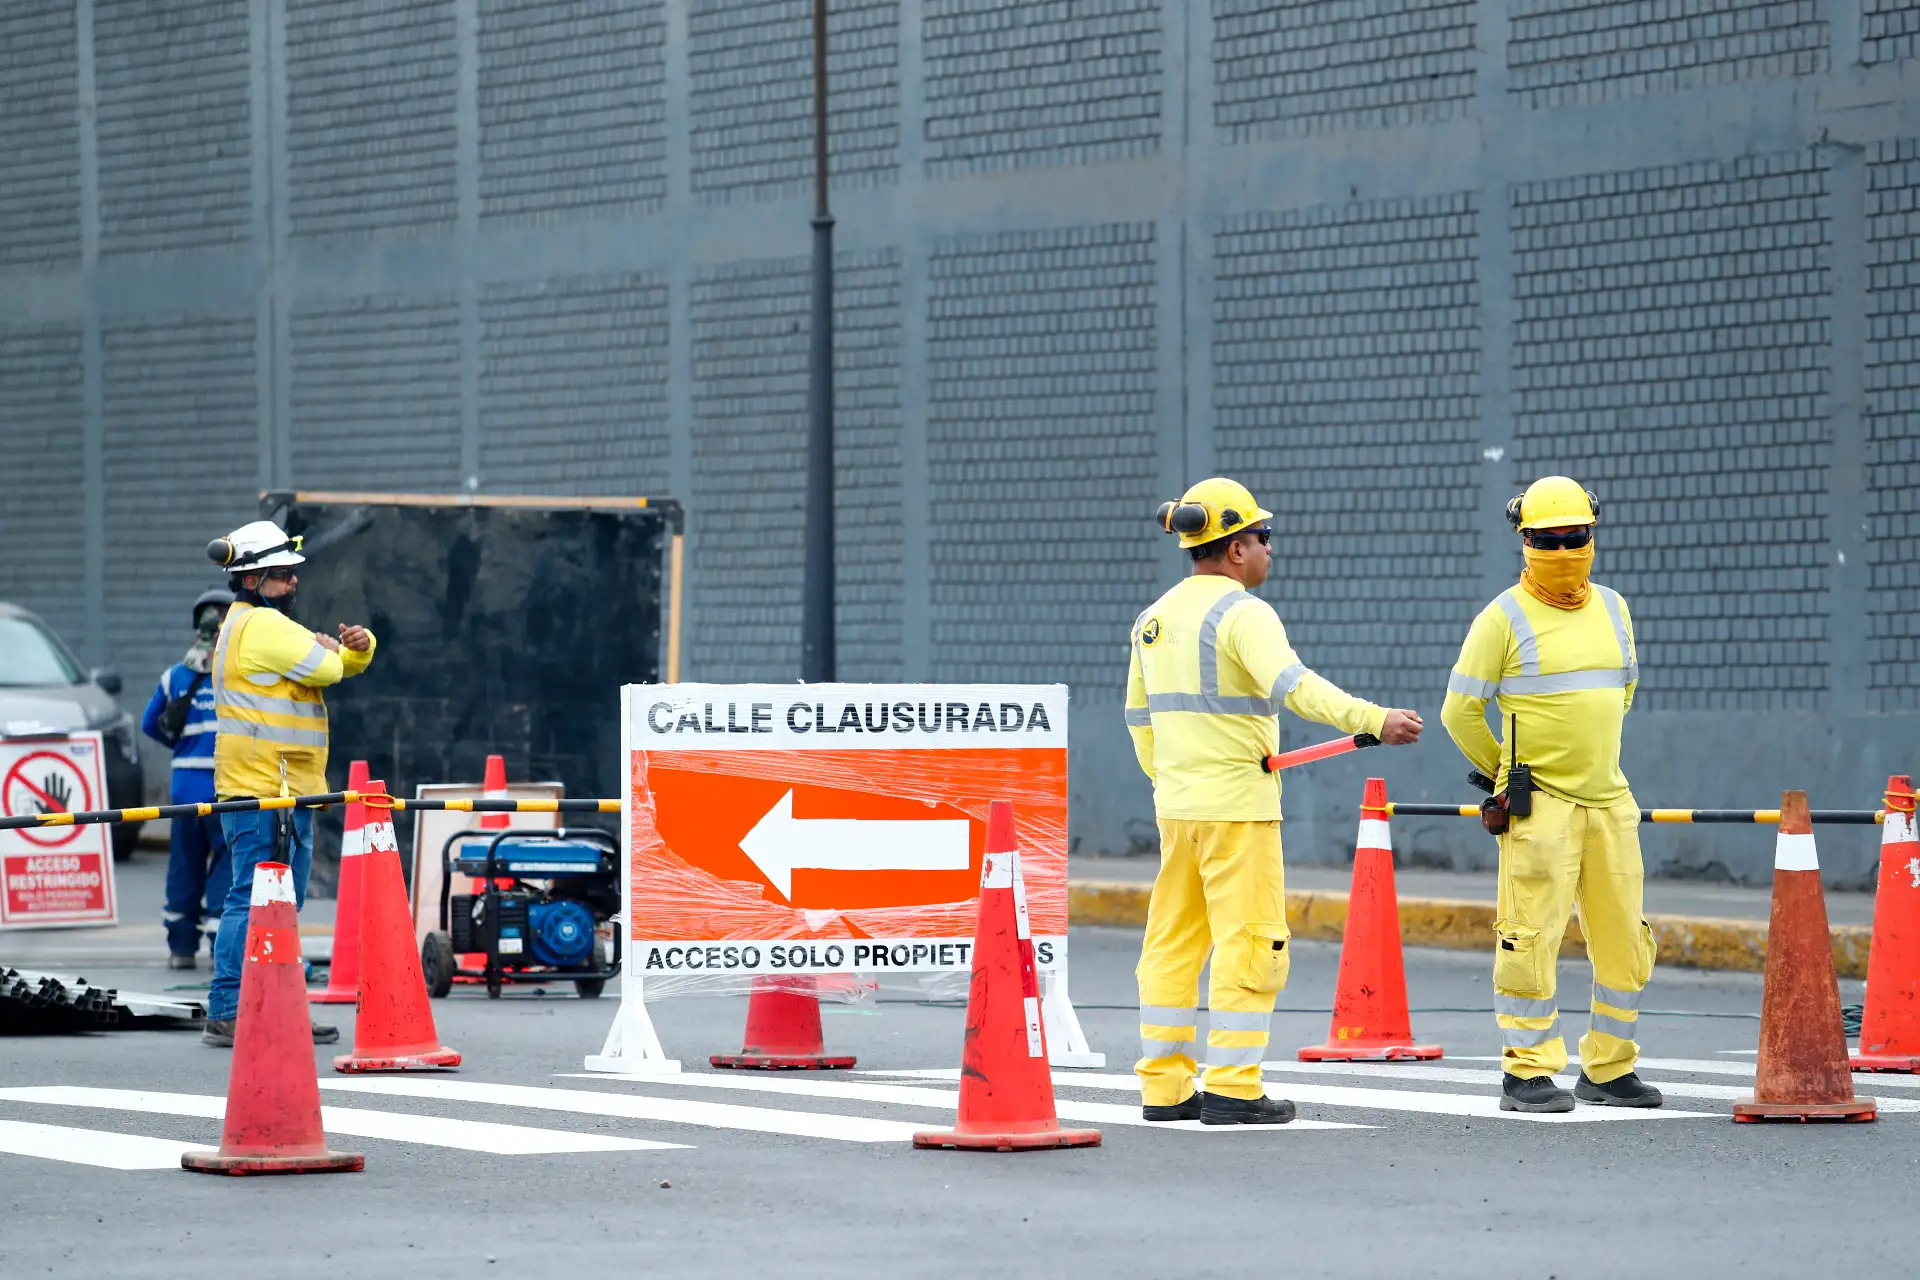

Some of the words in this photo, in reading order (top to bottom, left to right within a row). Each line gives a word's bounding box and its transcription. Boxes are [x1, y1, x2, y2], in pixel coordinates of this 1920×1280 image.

[647, 702, 773, 734] CALLE
[786, 701, 1052, 734] CLAUSURADA
[27, 856, 80, 873] ACCESO
[645, 945, 761, 969] ACCESO
[770, 944, 845, 969] SOLO
[854, 942, 1054, 968] PROPIETS
